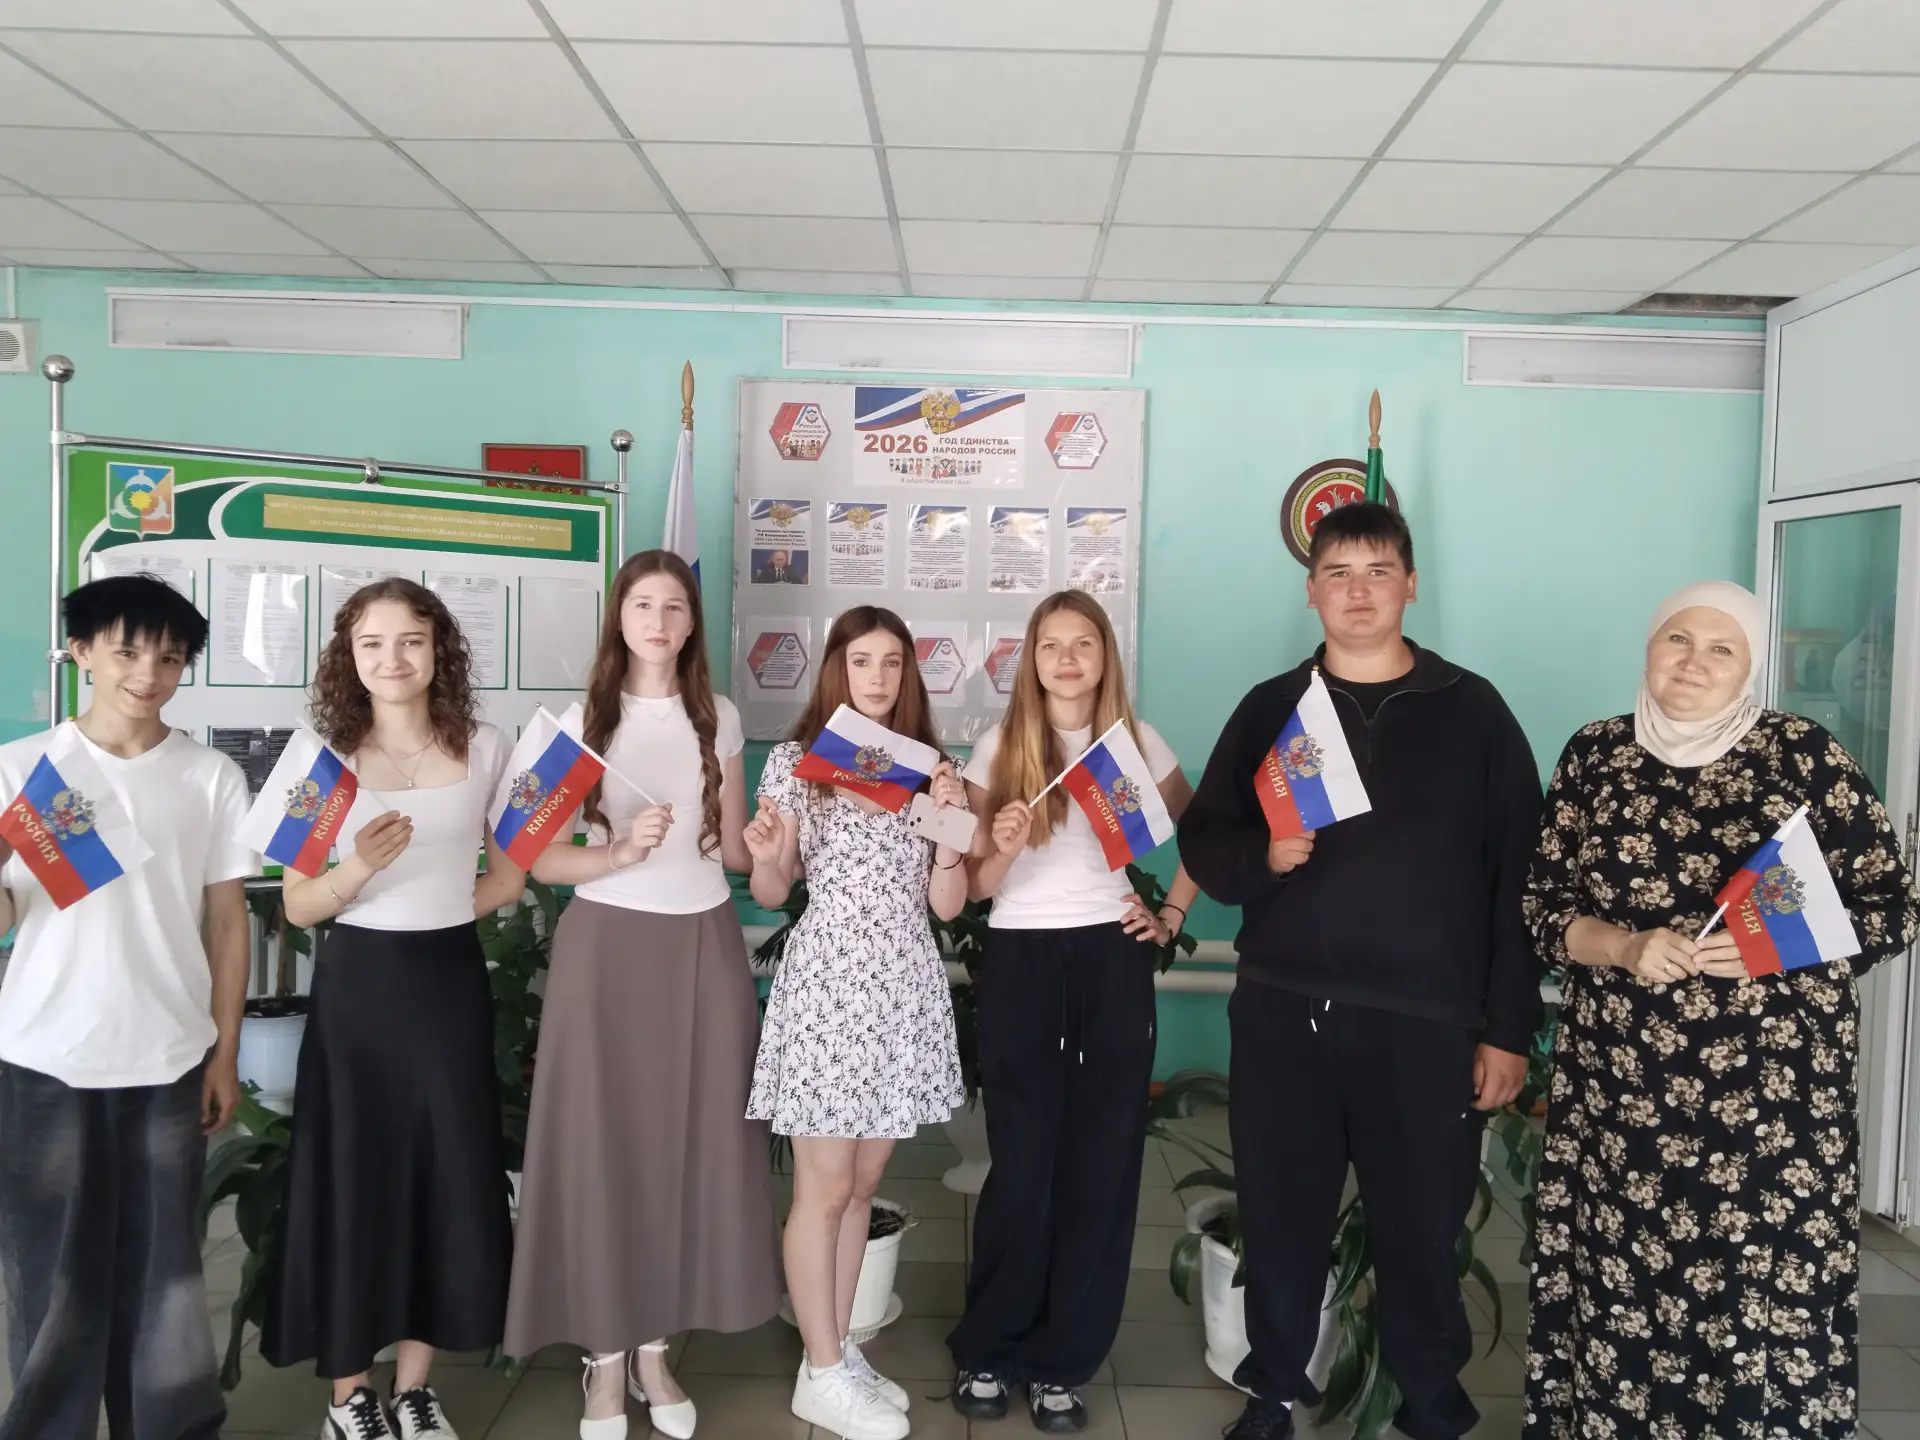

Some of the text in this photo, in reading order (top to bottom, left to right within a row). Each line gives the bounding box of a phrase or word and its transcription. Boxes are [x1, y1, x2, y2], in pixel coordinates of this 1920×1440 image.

[863, 433, 929, 454] 2026
[932, 446, 1016, 455] НАРОДОВ РОССИИ
[939, 437, 1010, 446] ГОД ЕДИНСТВА
[1088, 785, 1119, 834] РОССИЯ
[12, 803, 60, 865] РОССИЯ
